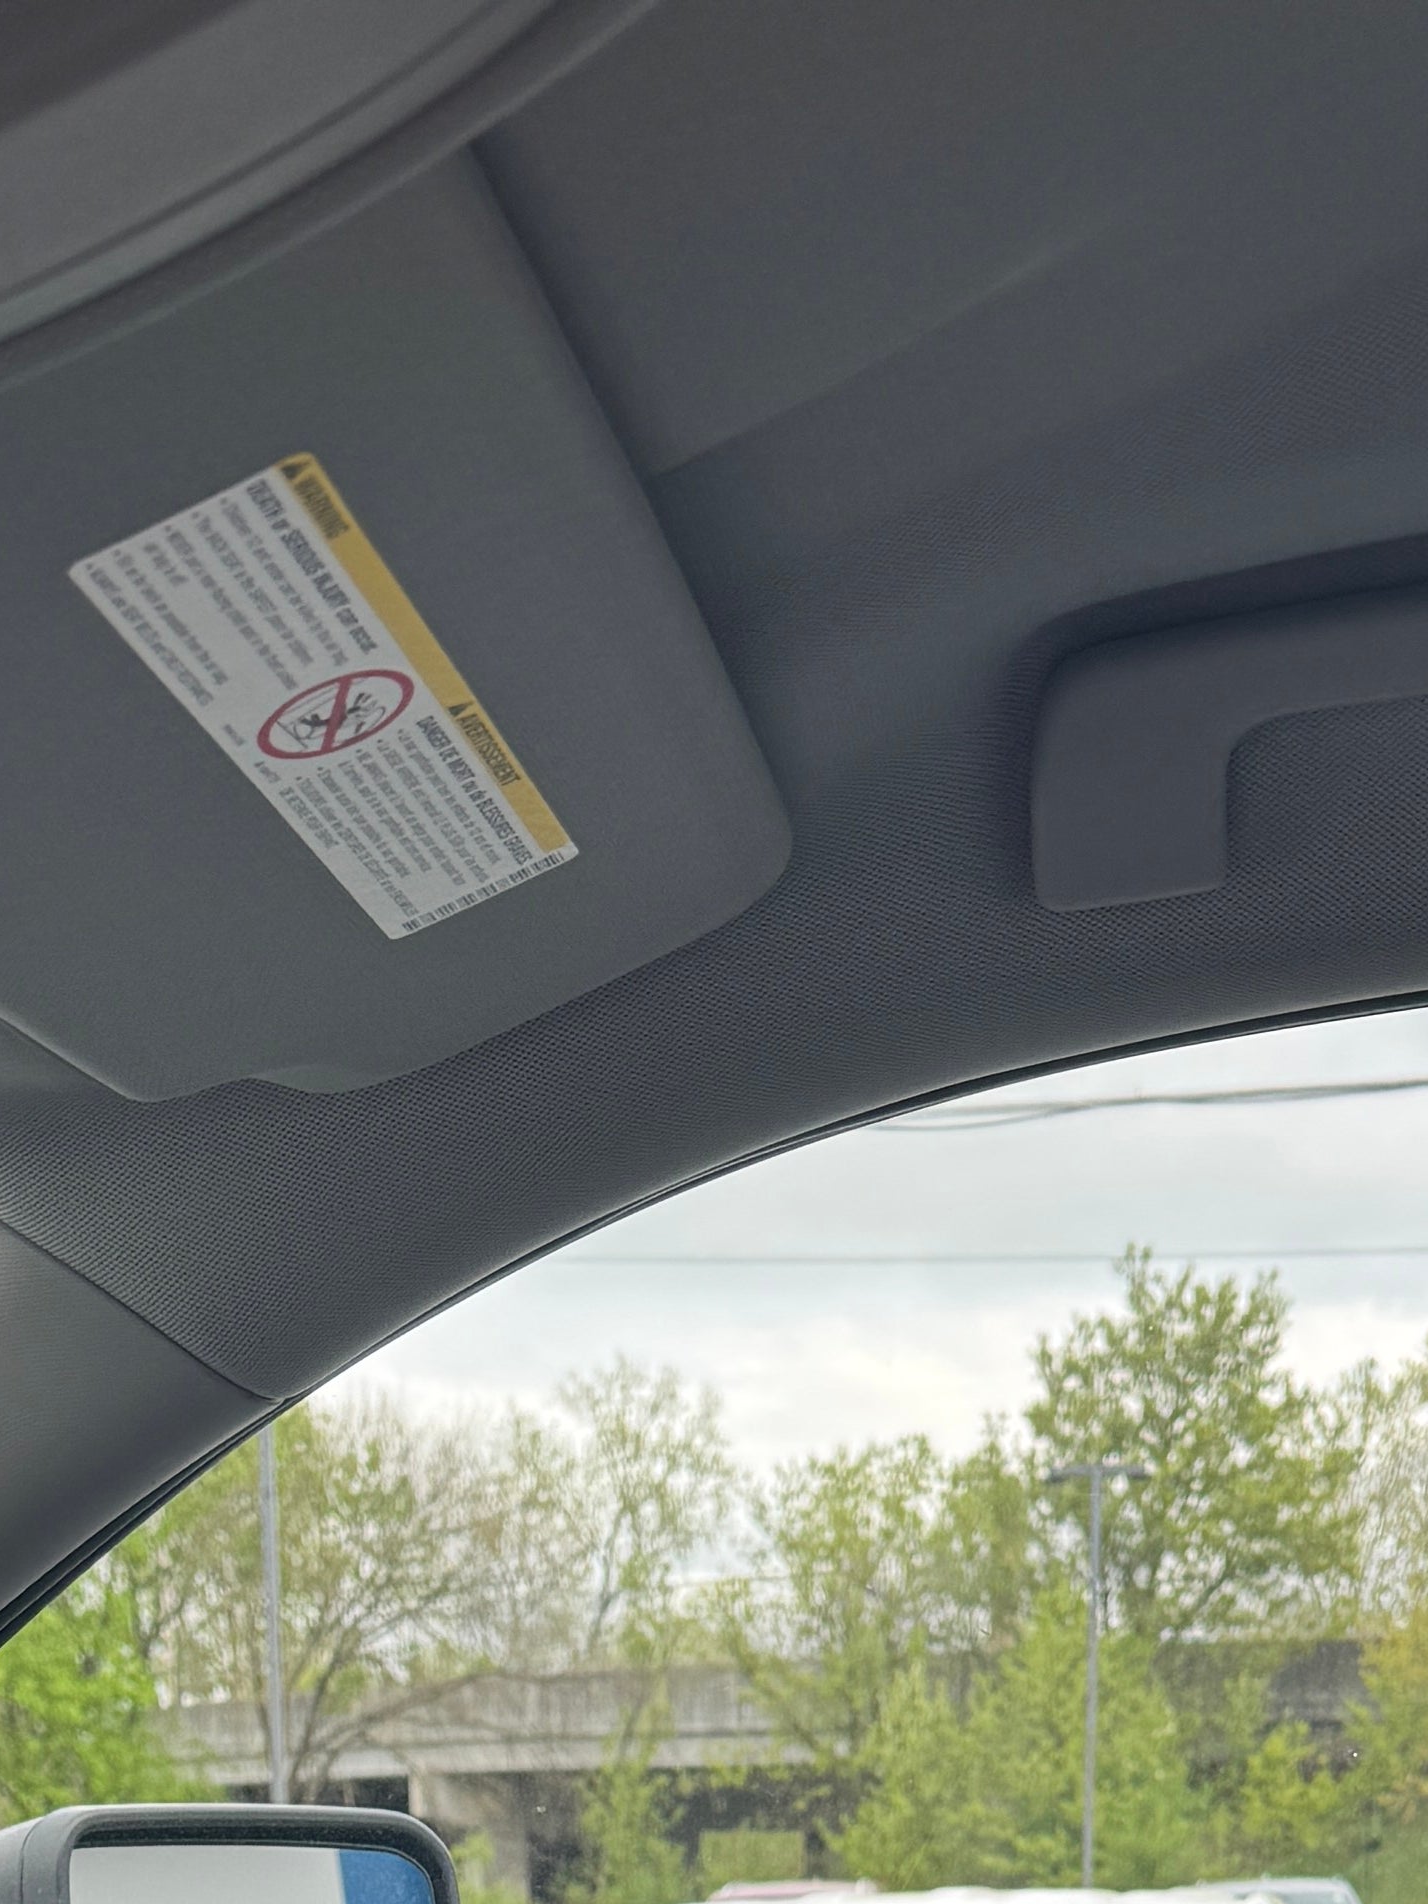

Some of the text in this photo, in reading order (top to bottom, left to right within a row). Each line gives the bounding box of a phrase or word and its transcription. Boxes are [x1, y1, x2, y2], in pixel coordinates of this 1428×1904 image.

[289, 473, 352, 541] WARNING
[415, 715, 451, 751] DANGER
[455, 710, 521, 788] AVERTISSEMENT
[437, 746, 459, 763] DE
[445, 757, 475, 784] MORT
[474, 797, 515, 841] BLESSURES
